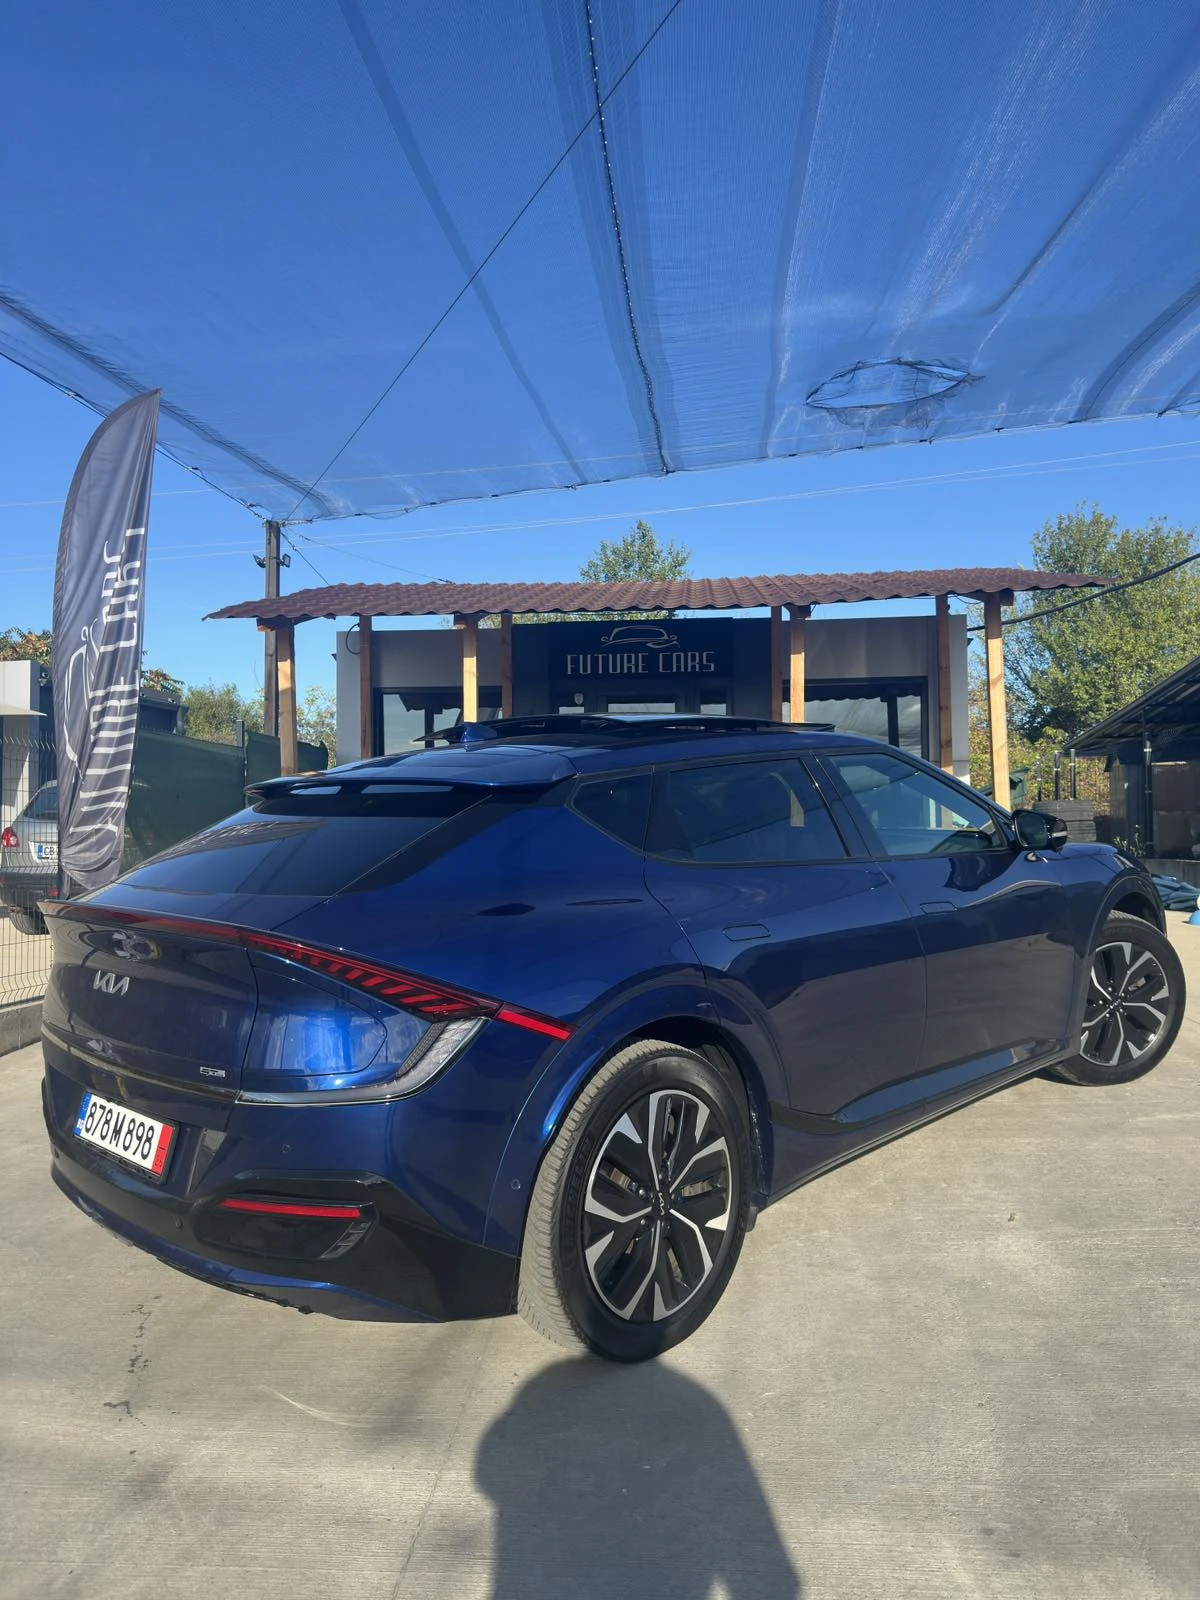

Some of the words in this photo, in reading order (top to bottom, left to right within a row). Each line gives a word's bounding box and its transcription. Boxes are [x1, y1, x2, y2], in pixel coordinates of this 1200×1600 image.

[566, 652, 649, 675] FUTURE
[659, 651, 715, 673] CARS
[93, 969, 130, 997] KIA
[84, 1101, 155, 1161] 878M898
